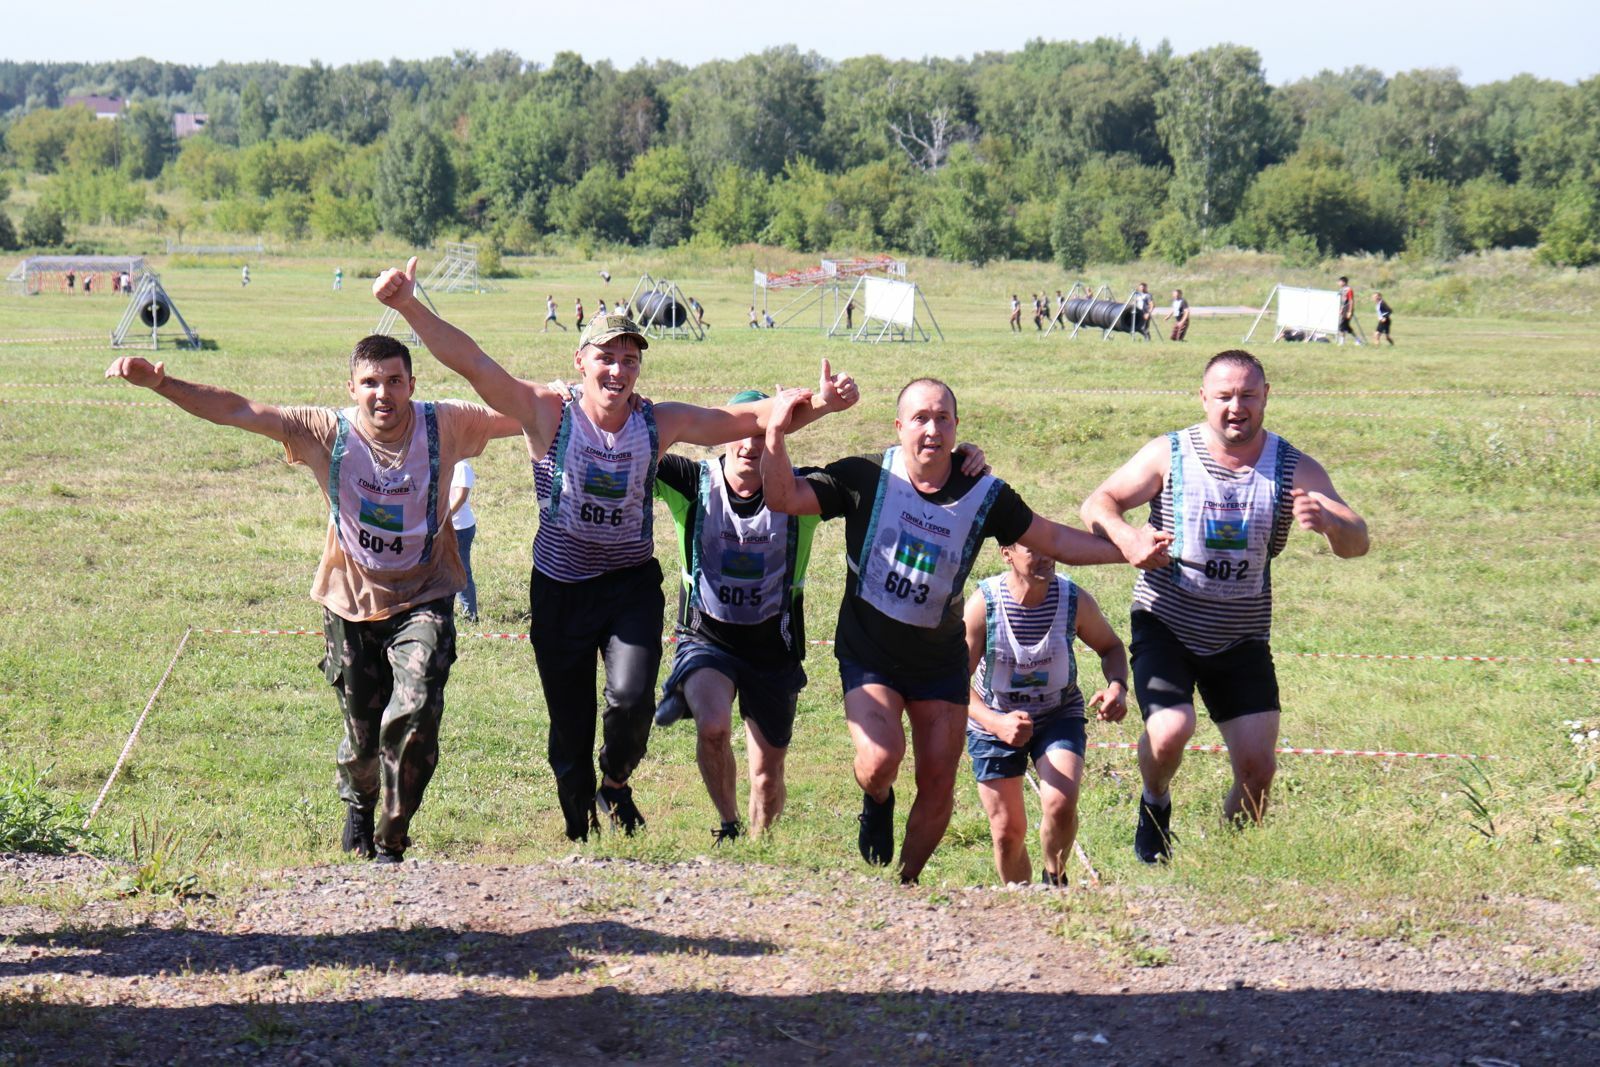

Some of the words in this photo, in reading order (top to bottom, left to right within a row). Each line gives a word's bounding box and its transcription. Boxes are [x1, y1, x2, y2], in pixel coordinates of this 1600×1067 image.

[587, 446, 608, 459] ГОНКА
[608, 452, 632, 460] ГЕРОЕВ
[359, 478, 380, 492] ГОНКА
[581, 502, 623, 527] 60-6
[1204, 500, 1225, 508] ГОНКА
[902, 511, 923, 527] ГОНКА
[924, 522, 951, 535] ГЕРОЕВ
[359, 529, 404, 555] 60-4
[1205, 560, 1249, 580] 60-2
[720, 585, 762, 607] 60-5
[884, 570, 930, 604] 60-3
